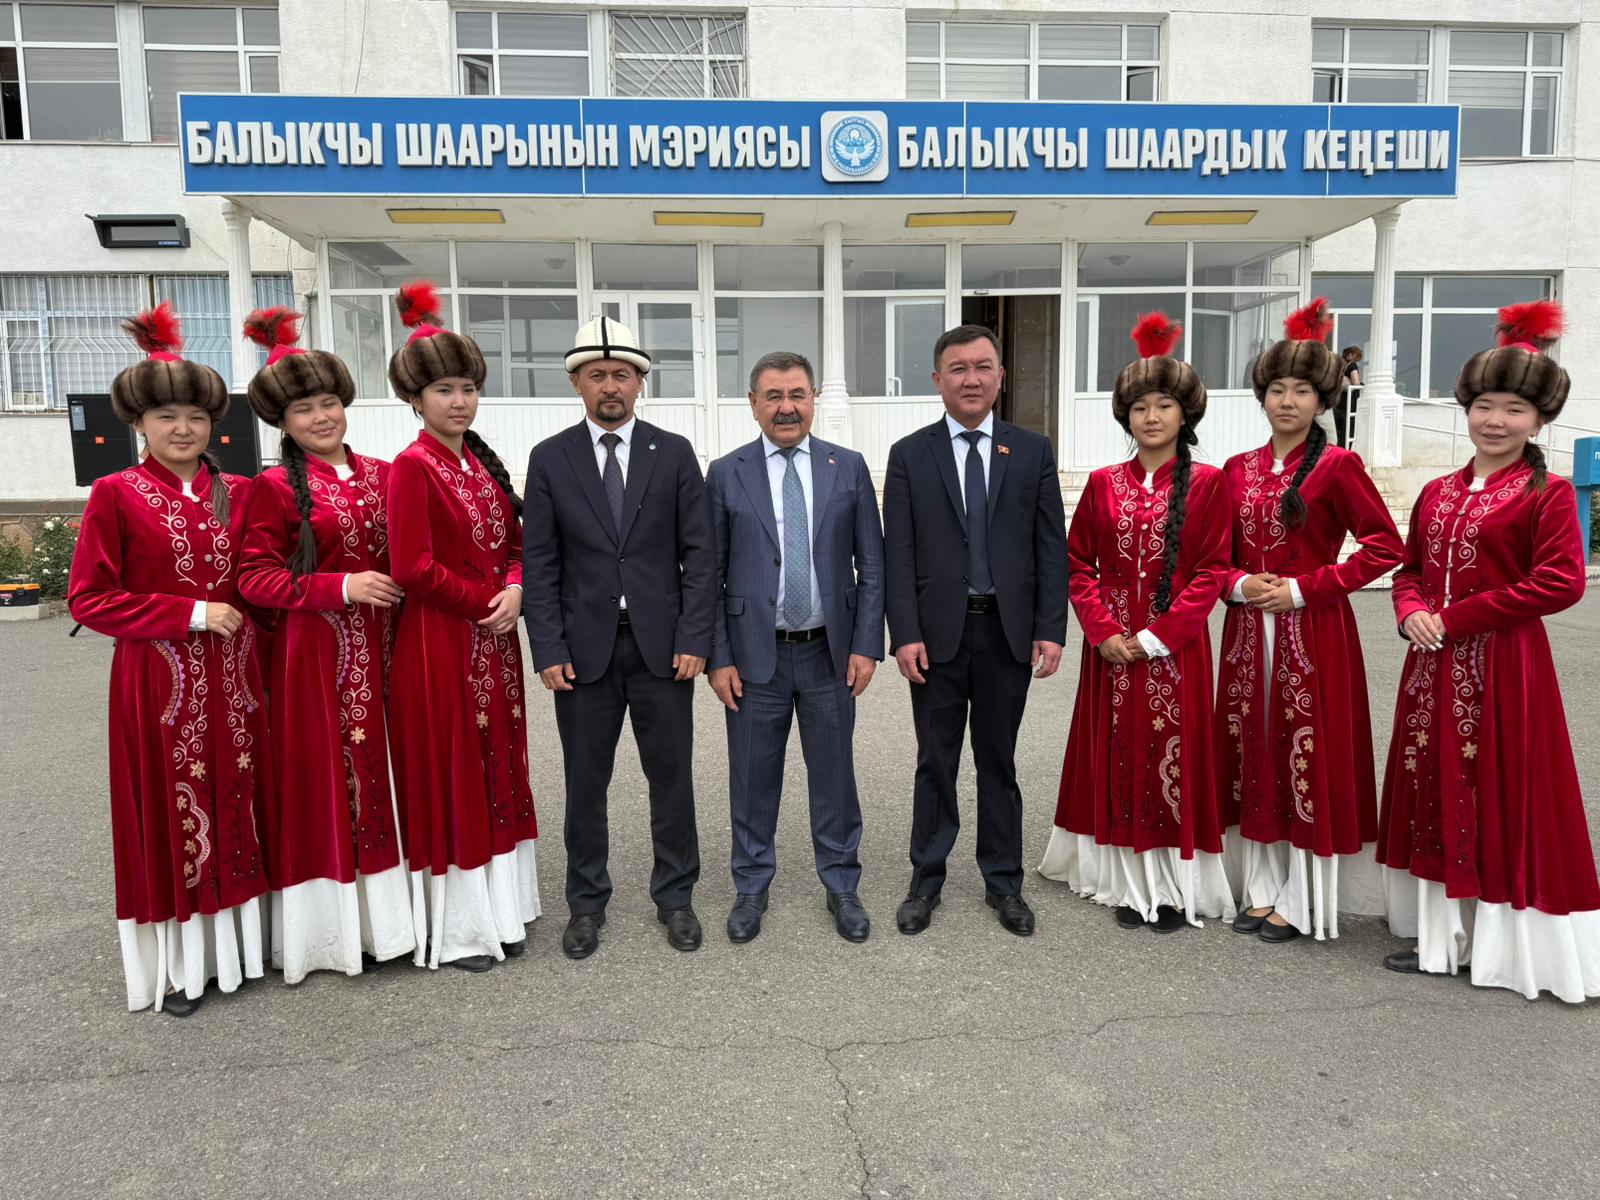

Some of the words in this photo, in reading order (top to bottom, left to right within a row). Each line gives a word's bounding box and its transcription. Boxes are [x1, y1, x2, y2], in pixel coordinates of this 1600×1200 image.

[187, 121, 383, 166] БАЛЫКЧЫ
[396, 123, 619, 168] ШААРЫНЫН
[630, 125, 811, 169] МЭРИЯСЫ
[898, 125, 1088, 170] БАЛЫКЧЫ
[1105, 127, 1287, 176] ШААРДЫК
[1304, 128, 1451, 177] КЕҢЕШИ
